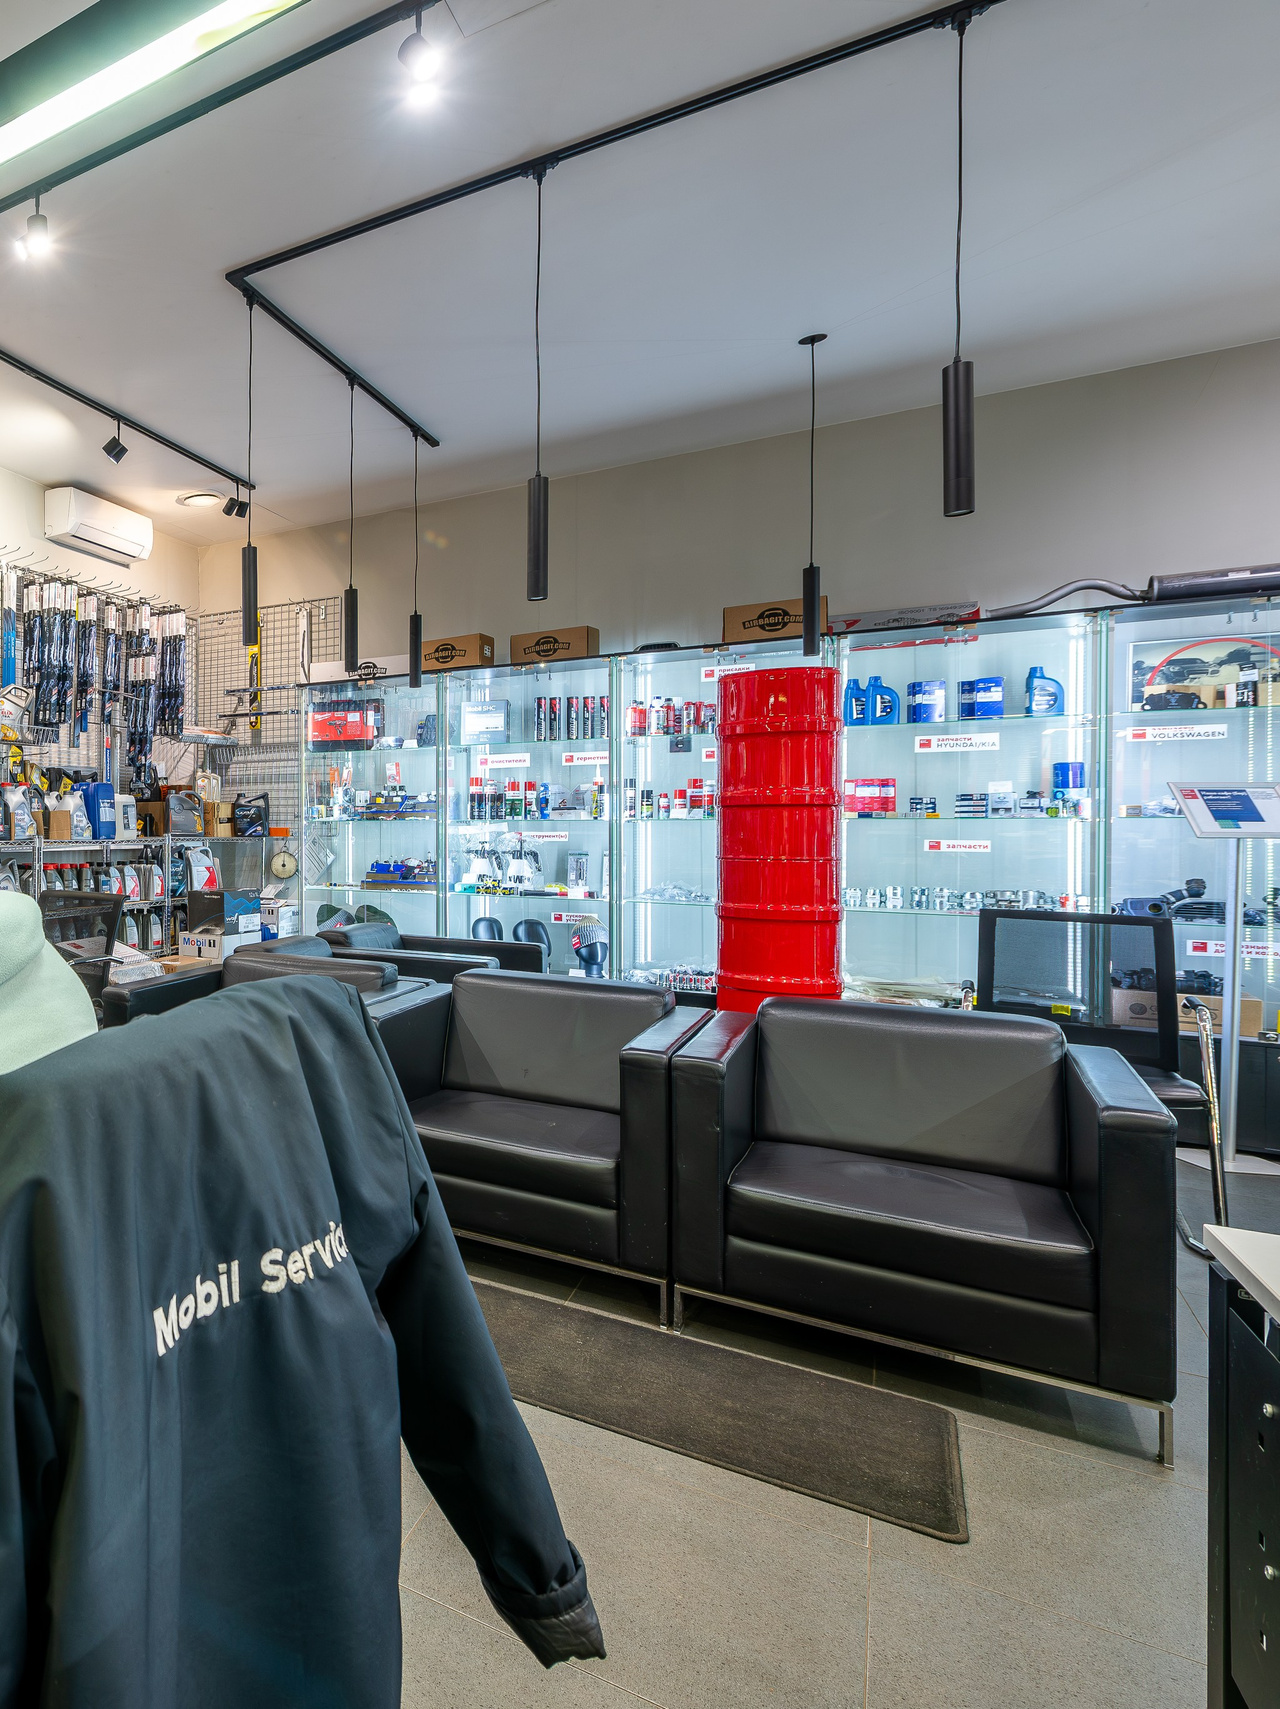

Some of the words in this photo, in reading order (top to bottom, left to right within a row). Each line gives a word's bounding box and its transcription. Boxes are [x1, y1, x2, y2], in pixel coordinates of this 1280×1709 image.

[744, 615, 803, 629] AIRBAGIT.COM
[524, 642, 570, 655] AIRBAGIT.COM
[425, 650, 466, 660] AIRBAGIT.COM
[1152, 731, 1225, 739] VOLKSWAGEN
[236, 808, 256, 819] wolf
[183, 937, 207, 947] Mobil
[152, 1259, 240, 1358] Mobil
[260, 1220, 348, 1294] Servic
